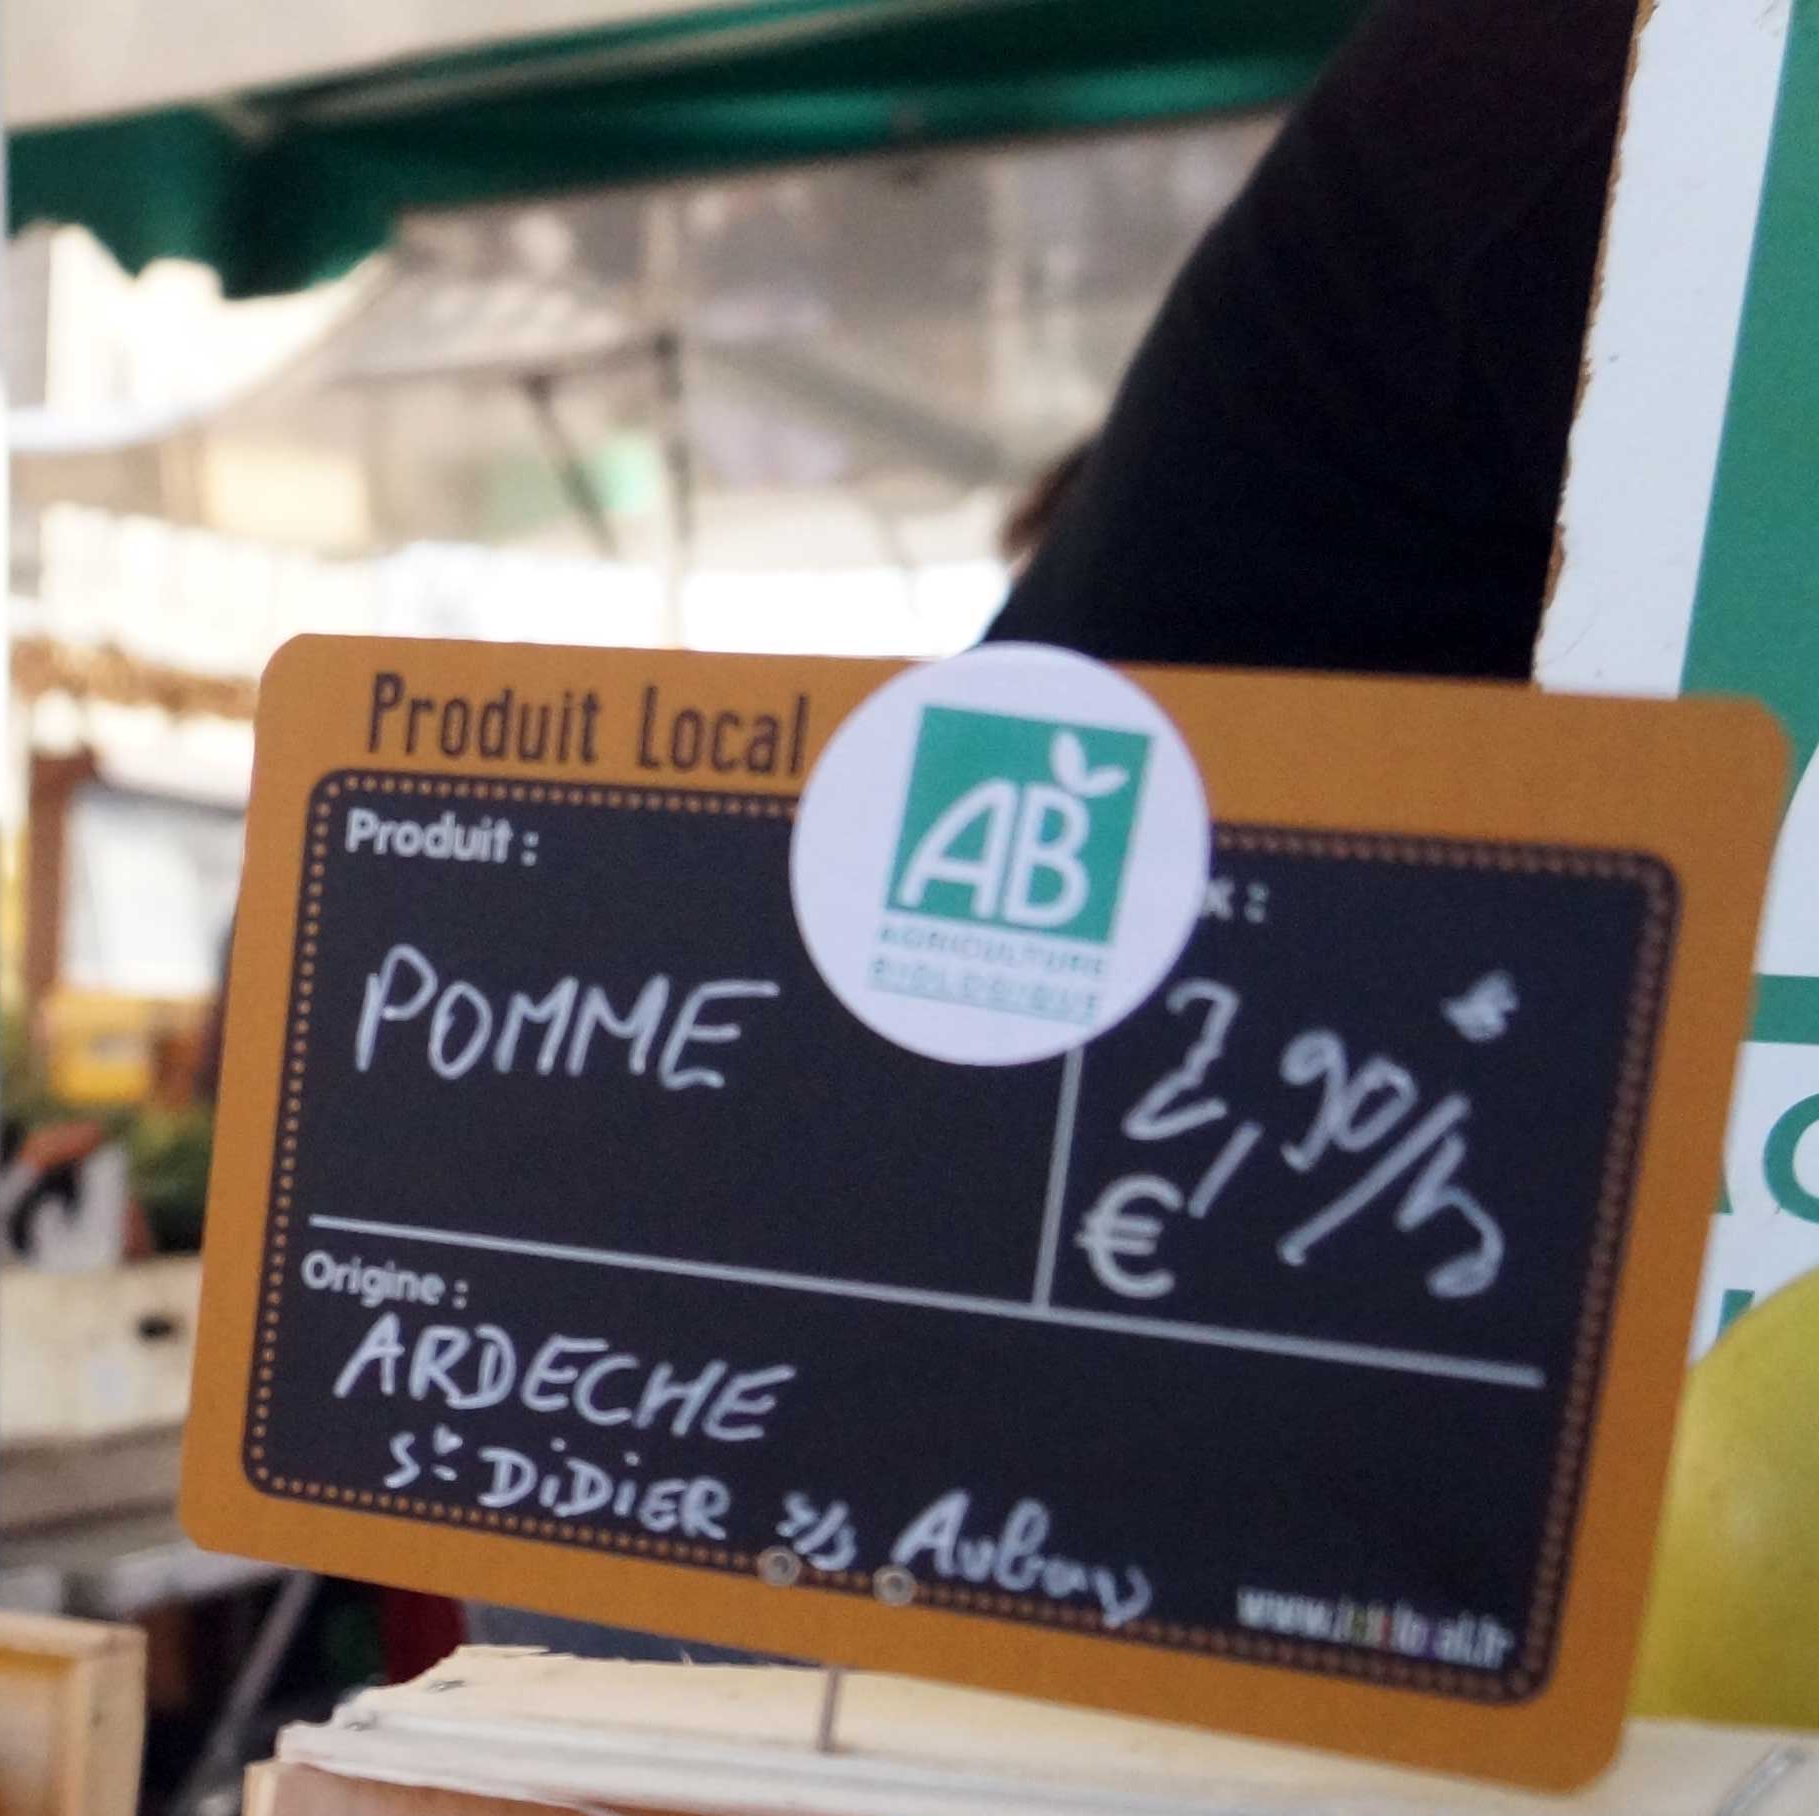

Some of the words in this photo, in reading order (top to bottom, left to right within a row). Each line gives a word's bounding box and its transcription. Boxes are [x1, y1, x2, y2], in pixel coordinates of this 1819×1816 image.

[368, 671, 600, 764] Produit
[641, 684, 810, 777] Local
[898, 777, 1090, 927] AB
[356, 943, 781, 1090] POMME
[1075, 1174, 1184, 1299] €
[333, 1311, 797, 1442] ARDECHE
